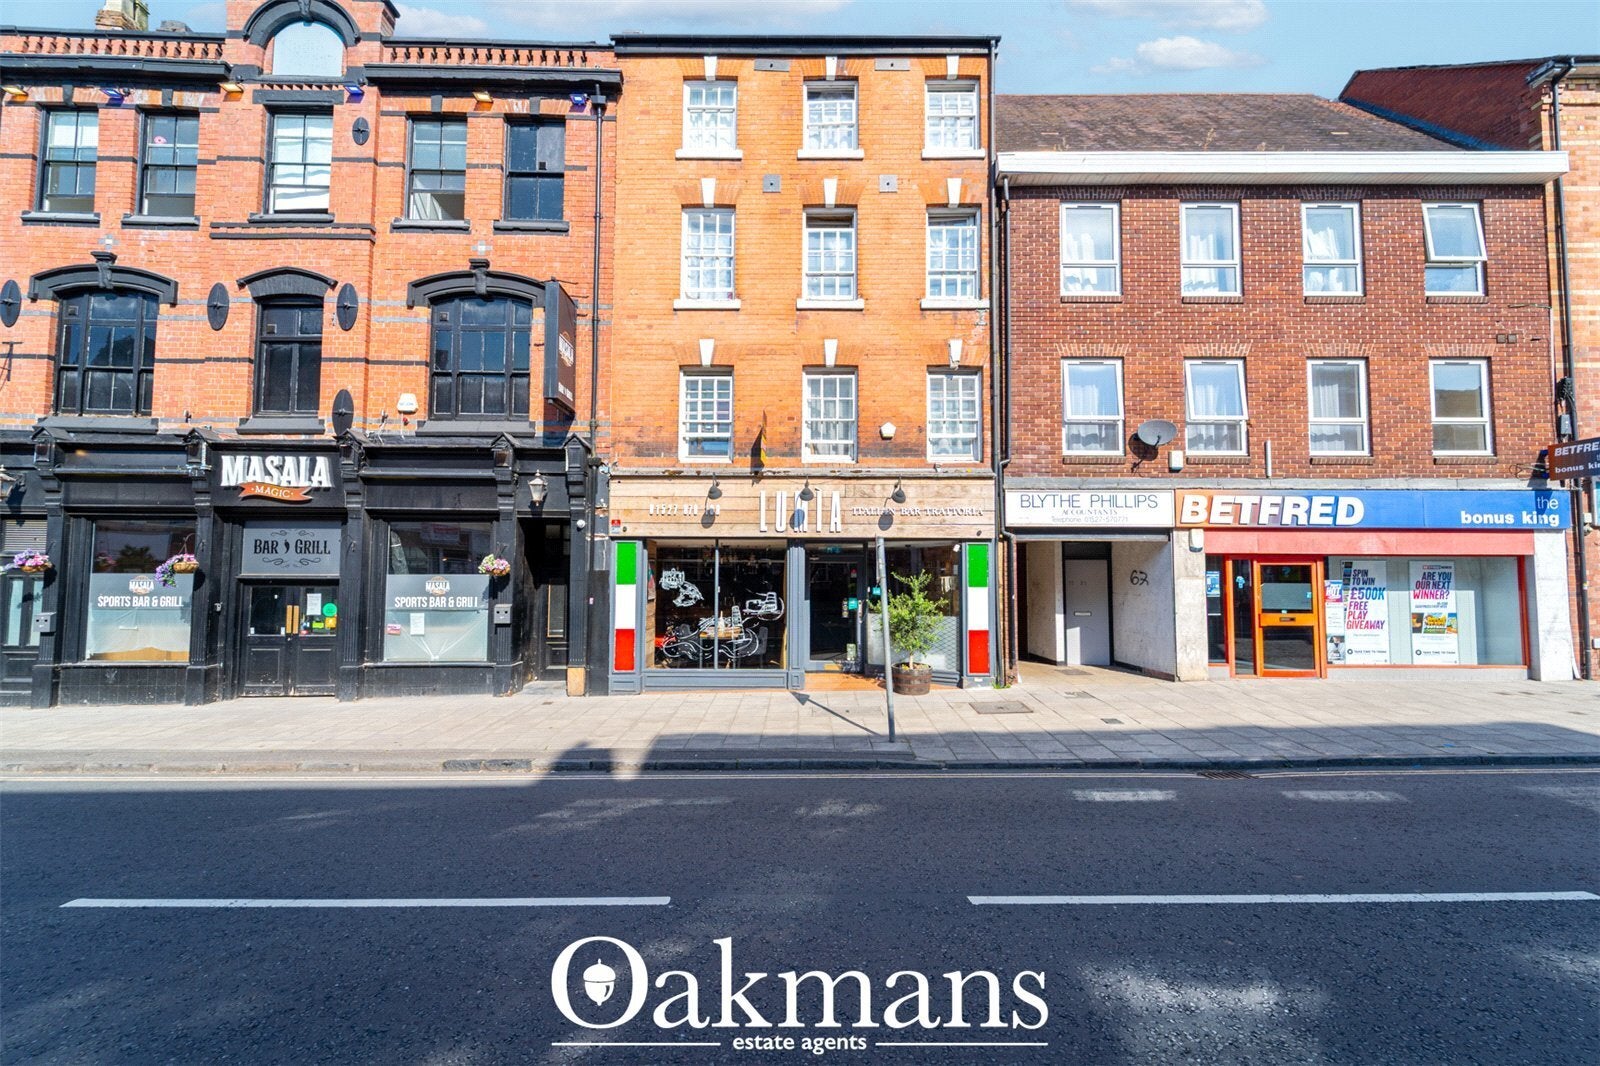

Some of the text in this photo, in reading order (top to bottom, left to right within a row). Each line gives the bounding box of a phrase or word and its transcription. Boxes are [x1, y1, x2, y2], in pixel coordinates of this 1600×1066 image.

[1554, 441, 1600, 457] BETFRE
[220, 455, 333, 488] MASALA
[1555, 462, 1600, 474] bonus ki
[255, 485, 290, 498] MAGIC
[1020, 494, 1158, 508] BLYTHE PHILLIPS
[1537, 496, 1559, 509] the
[852, 507, 983, 516] ITALIAN BAR TRATTORIA
[1180, 494, 1365, 526] BETFRED
[1461, 511, 1560, 527] bonus king
[254, 539, 331, 554] BAR GRILL
[1352, 569, 1369, 577] SPIN
[1422, 572, 1452, 581] ARE YOU
[129, 581, 155, 591] MASALA
[425, 581, 451, 591] MASALA
[1415, 581, 1451, 589] OUR NEXT
[1350, 587, 1386, 600] £500K
[1413, 590, 1450, 599] WINNER?
[97, 595, 184, 607] SPORTS BAR & GRILL
[394, 596, 427, 608] SPORTS
[429, 596, 446, 608] BAR
[448, 596, 454, 608] &
[1349, 601, 1368, 610] FREE
[1347, 611, 1368, 620] PLAY
[1346, 620, 1385, 629] GIVEAWAY
